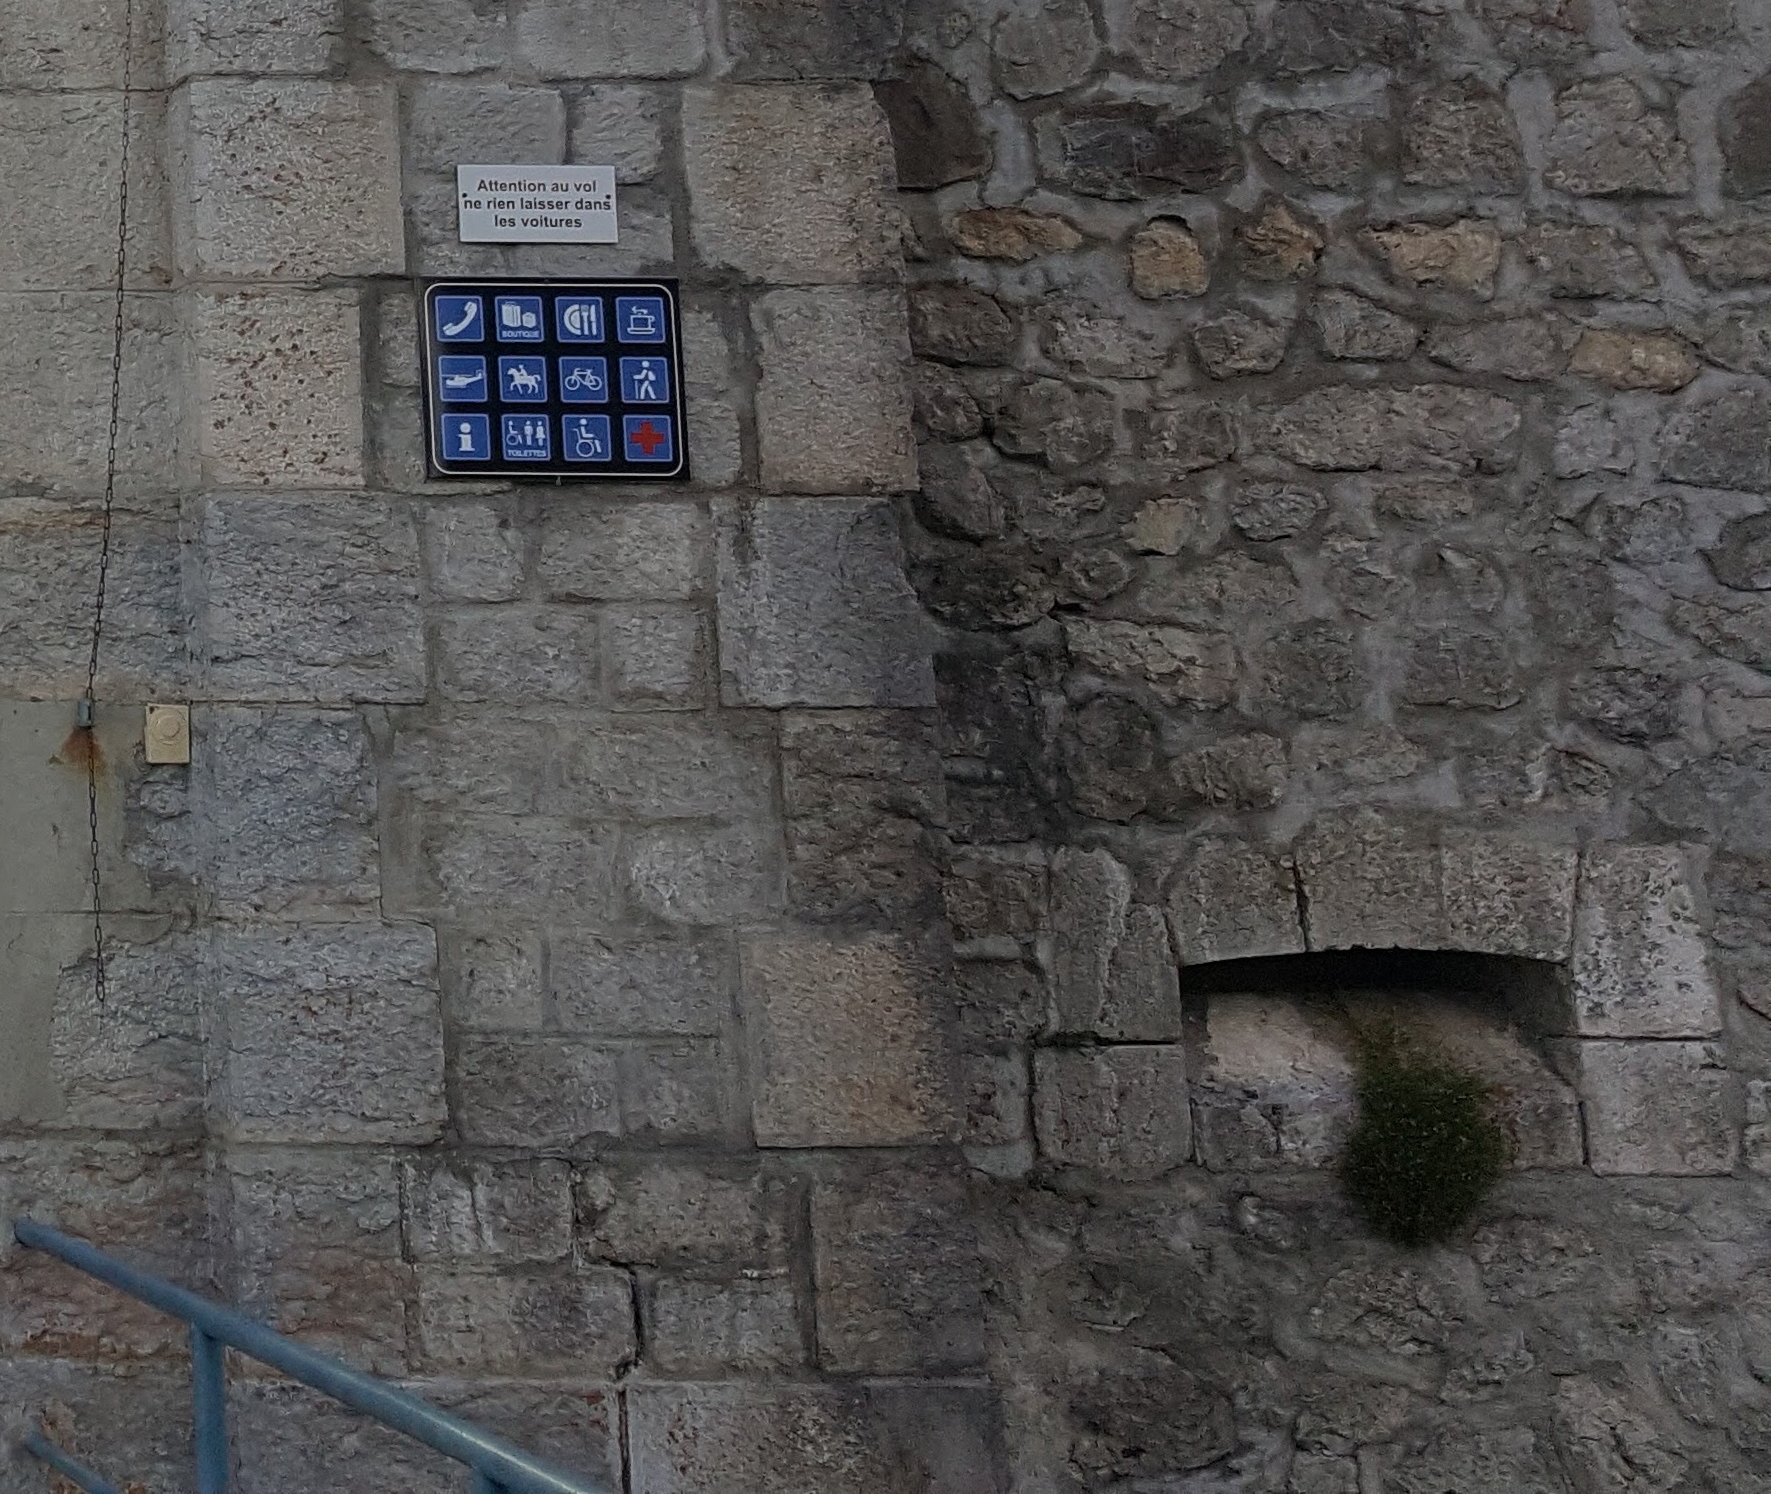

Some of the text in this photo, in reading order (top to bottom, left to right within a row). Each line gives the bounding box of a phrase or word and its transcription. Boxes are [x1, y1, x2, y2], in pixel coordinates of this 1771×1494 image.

[477, 179, 596, 193] Attention au vol
[463, 197, 611, 211] ne rien laisser dans
[494, 215, 582, 228] les voitures
